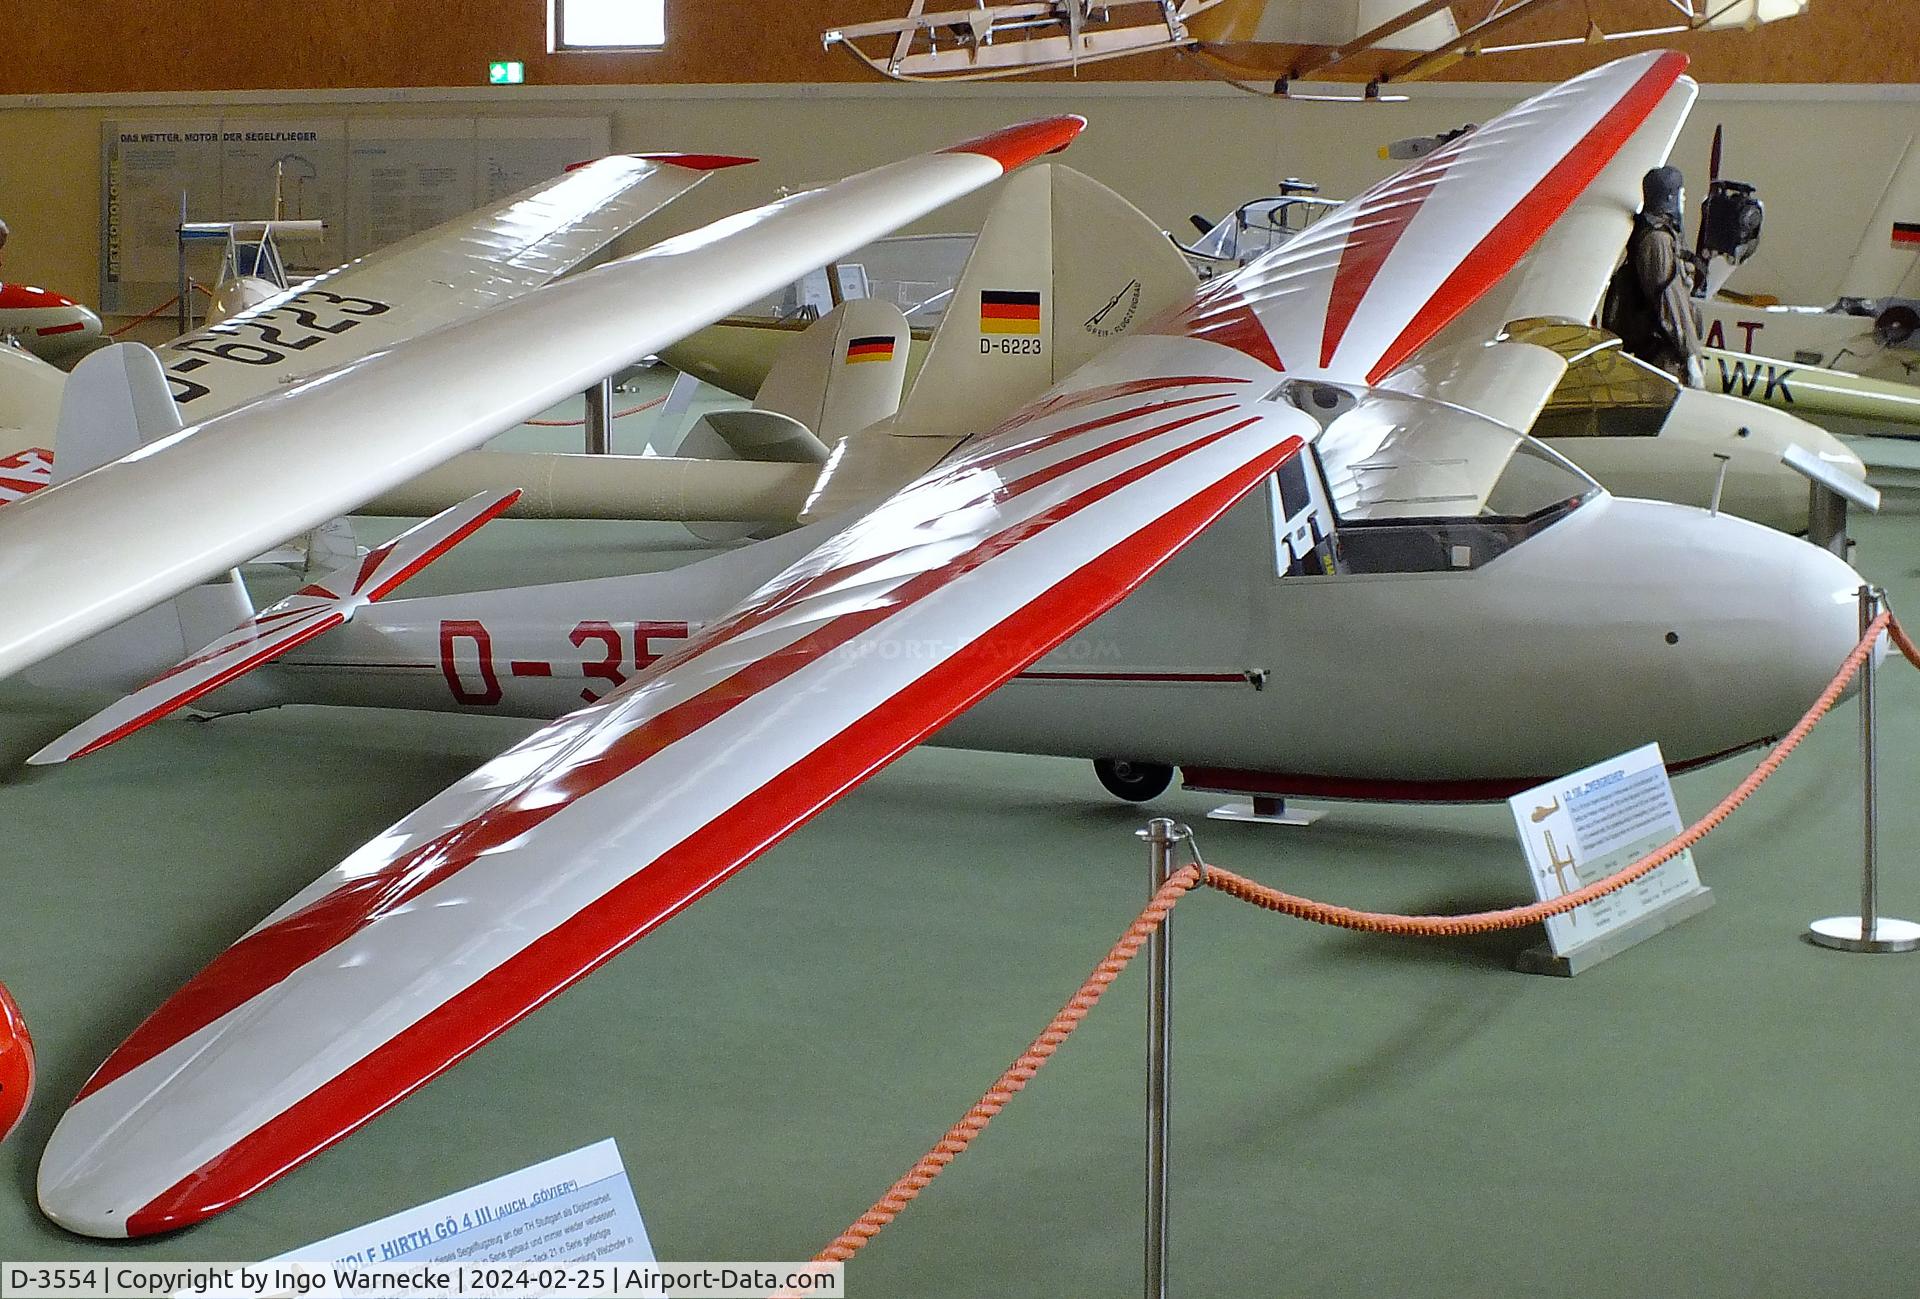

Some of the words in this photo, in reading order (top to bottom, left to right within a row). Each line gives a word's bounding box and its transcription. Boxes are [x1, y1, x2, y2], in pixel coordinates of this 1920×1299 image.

[120, 133, 140, 143] DAS
[184, 132, 218, 142] MOTOR
[223, 132, 242, 142] DER
[245, 132, 317, 142] SEGELFLIEGER
[980, 338, 1041, 354] D-6223
[381, 1227, 433, 1260] HIRTH
[435, 1215, 459, 1240] GÖ
[463, 1213, 473, 1229] 4
[475, 1206, 492, 1226] III
[495, 1197, 528, 1219] (AUCH
